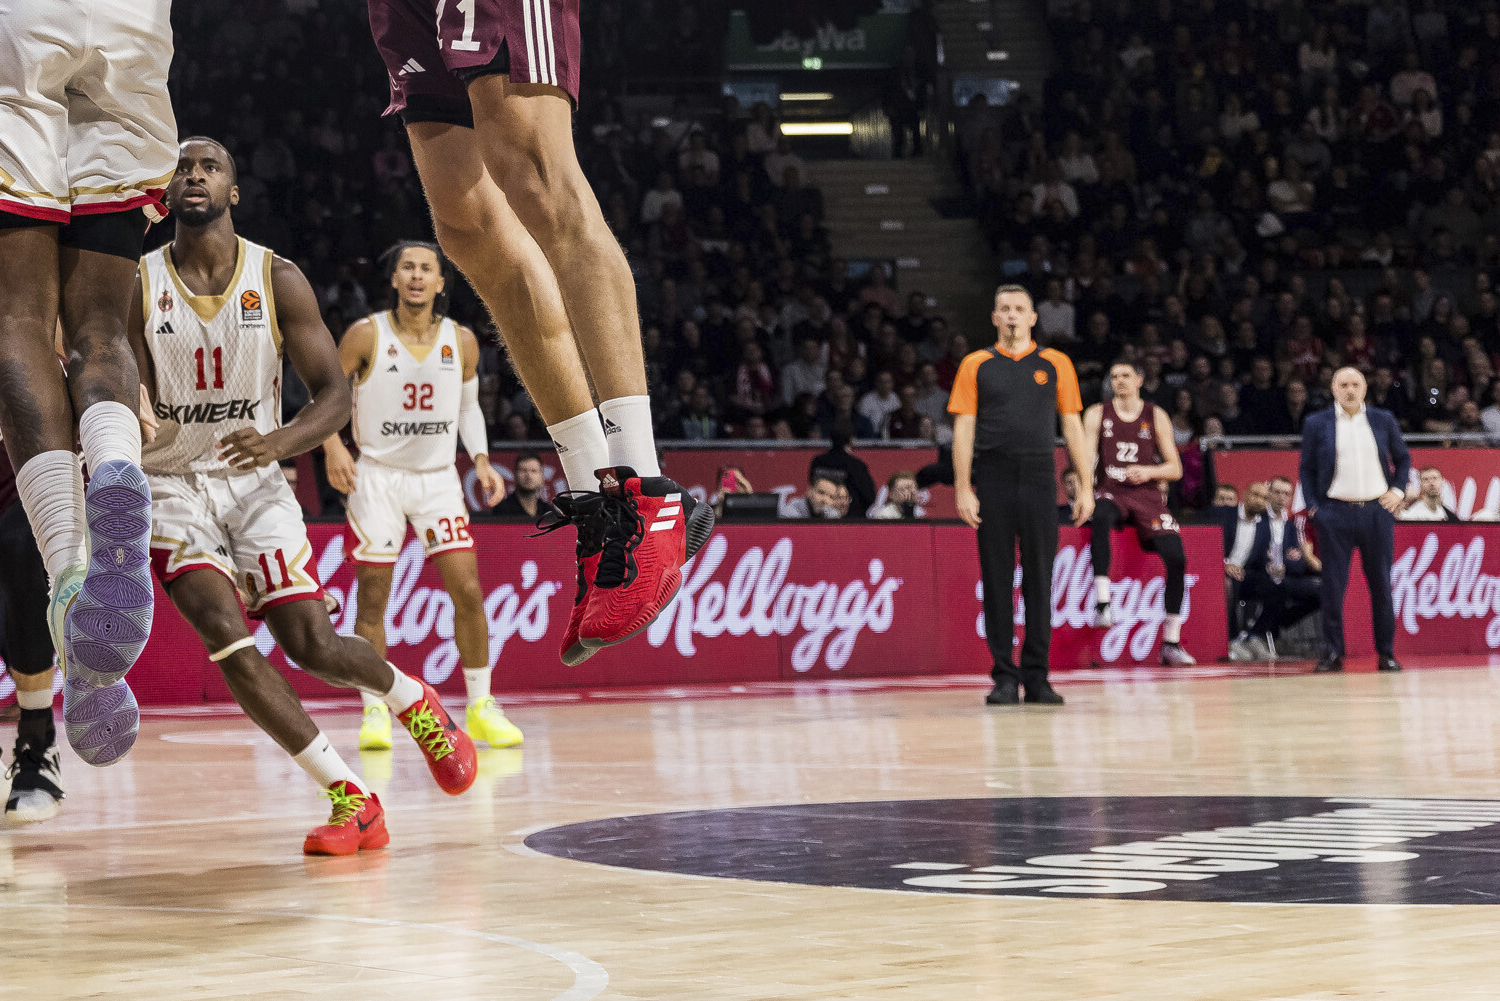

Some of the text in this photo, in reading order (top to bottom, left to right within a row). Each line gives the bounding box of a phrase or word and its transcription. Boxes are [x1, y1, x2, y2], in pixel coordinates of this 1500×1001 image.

[194, 346, 225, 391] 11
[403, 383, 434, 411] 32
[154, 398, 261, 426] SKWEEK
[380, 420, 455, 436] SKWEEK
[1116, 441, 1139, 463] 22
[439, 516, 471, 544] 32
[259, 549, 294, 593] 11
[647, 533, 902, 672] Kellogg's
